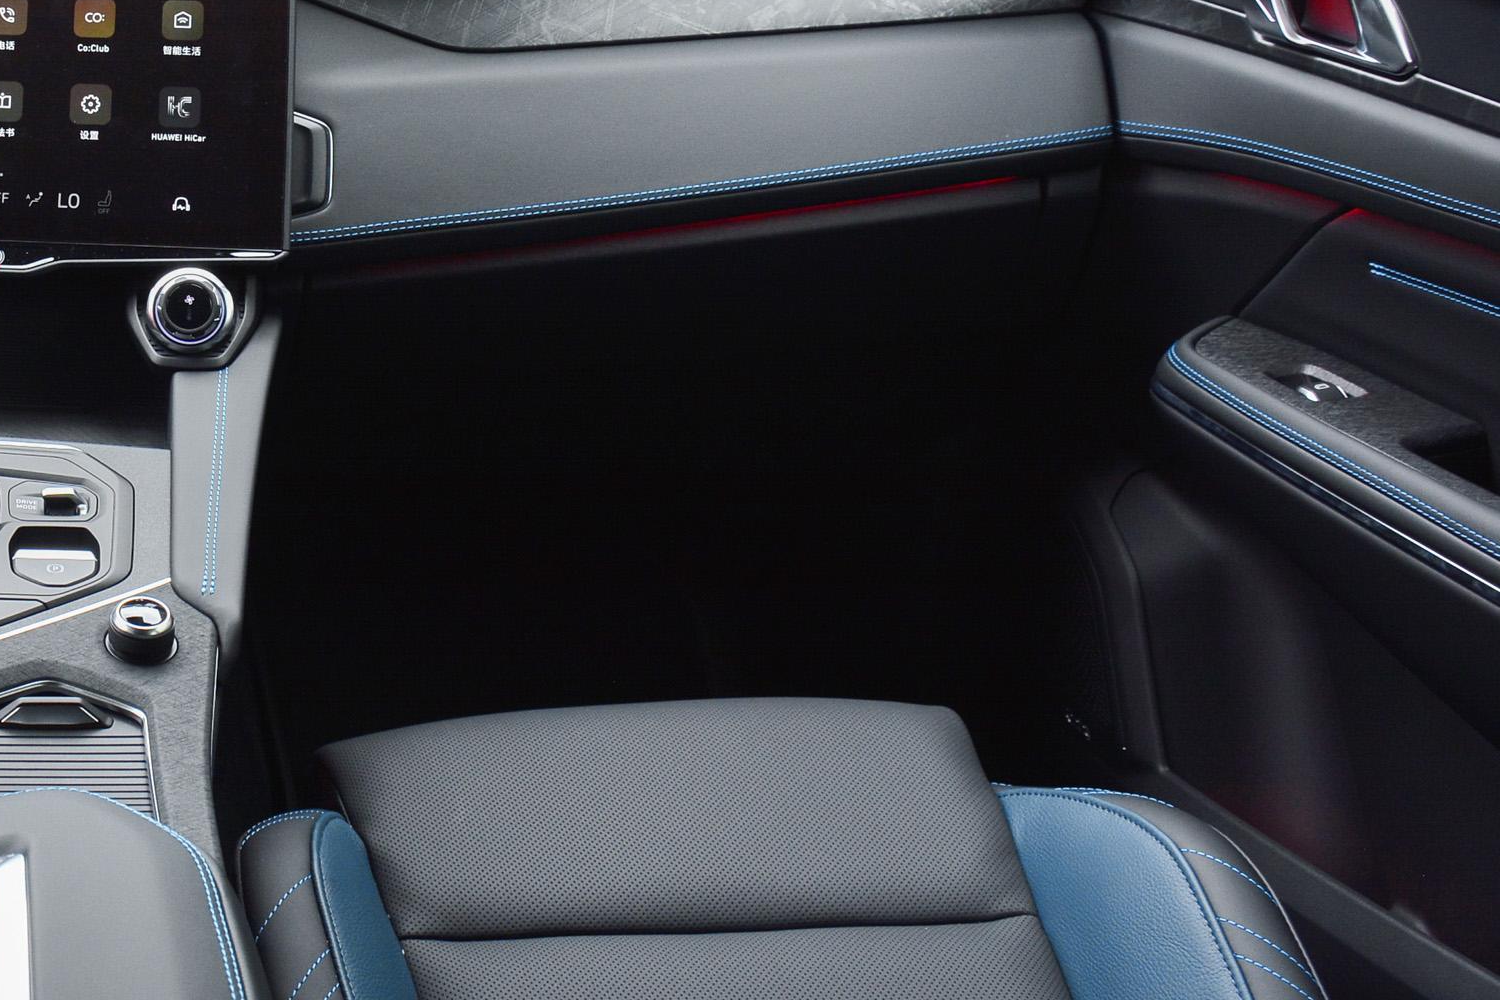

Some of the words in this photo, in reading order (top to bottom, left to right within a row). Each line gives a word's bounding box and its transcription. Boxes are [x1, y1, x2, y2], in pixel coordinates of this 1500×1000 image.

[77, 44, 110, 53] Co:Club
[163, 46, 202, 57] 智能生活
[80, 130, 99, 141] 设置
[151, 132, 183, 142] HUAWEI
[184, 133, 206, 143] HiCar
[57, 193, 80, 209] LO
